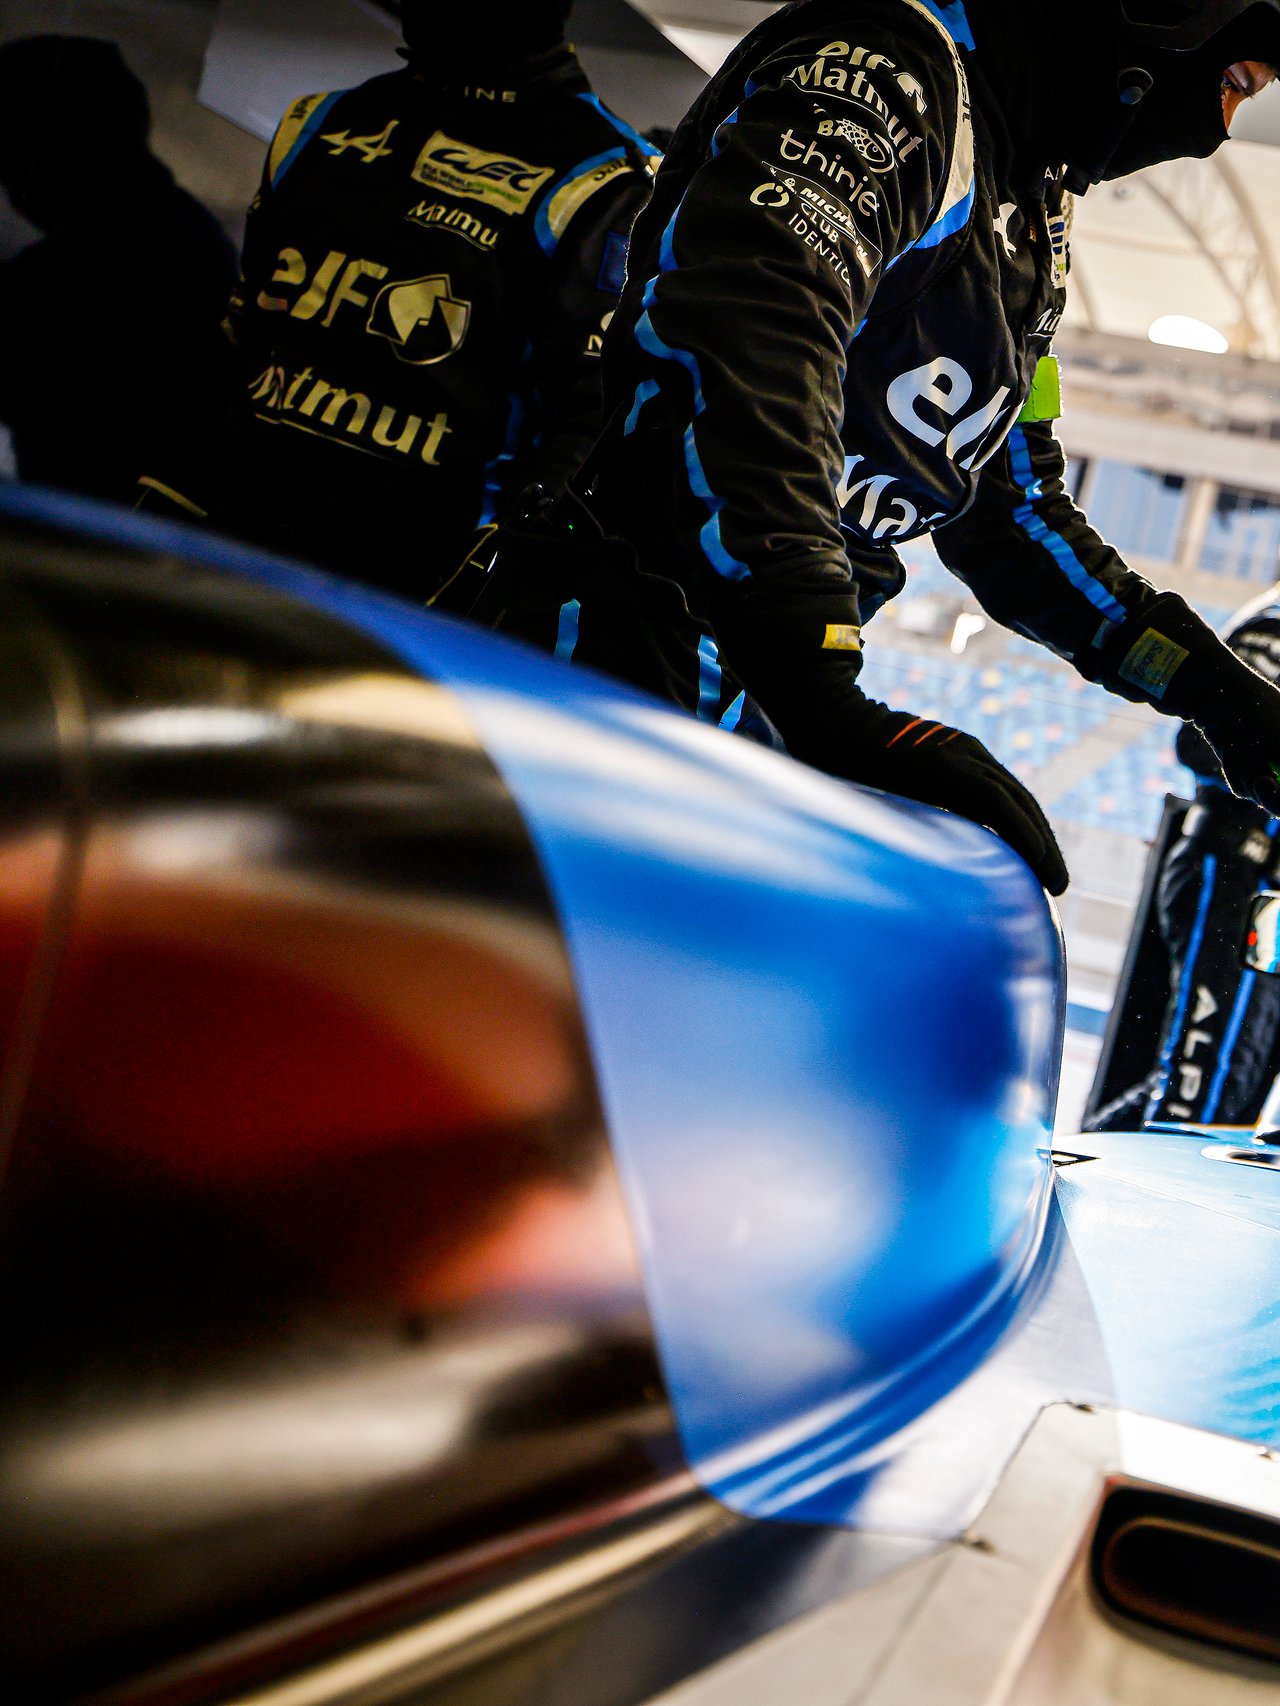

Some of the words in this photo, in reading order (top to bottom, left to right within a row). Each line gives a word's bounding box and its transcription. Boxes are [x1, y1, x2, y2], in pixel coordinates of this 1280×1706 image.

[788, 213, 852, 287] IDENTIC
[800, 187, 868, 258] MICHEN
[801, 202, 839, 244] CLUB
[1164, 985, 1219, 1119] ALPI
